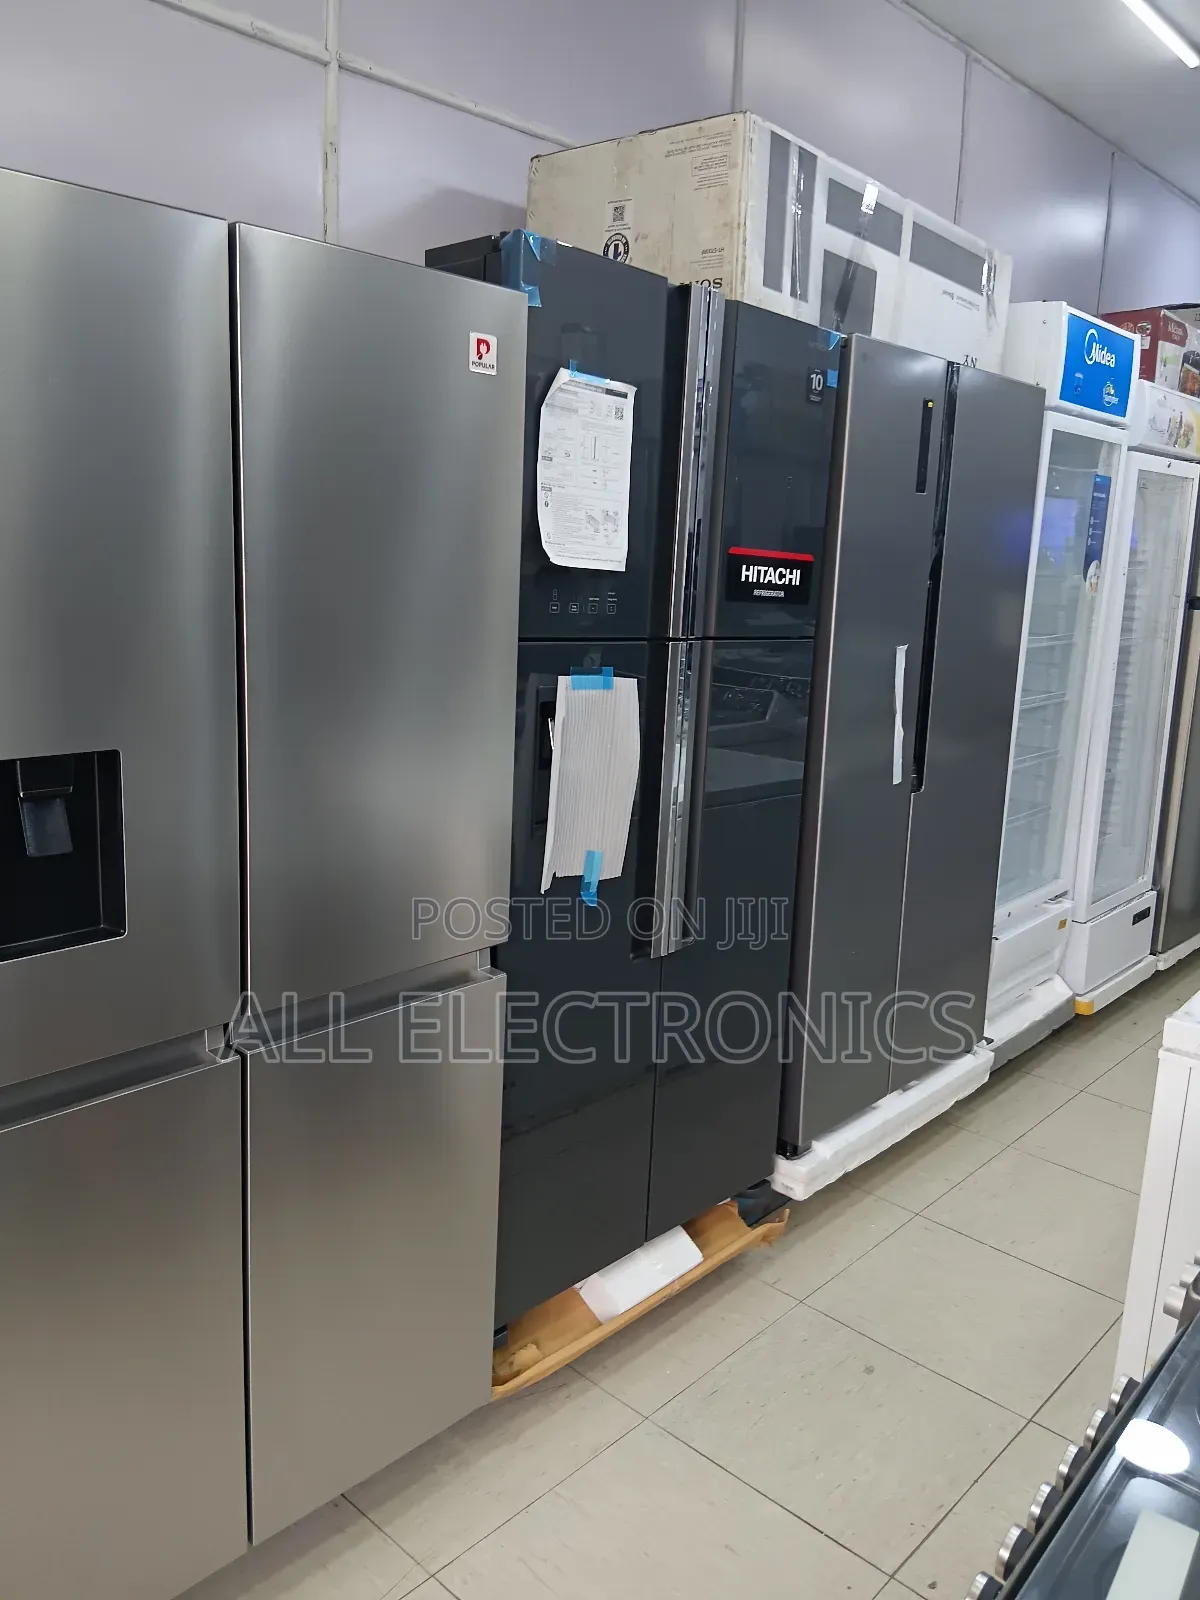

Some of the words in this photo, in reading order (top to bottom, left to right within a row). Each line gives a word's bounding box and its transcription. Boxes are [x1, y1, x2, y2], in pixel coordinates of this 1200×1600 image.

[1085, 331, 1116, 368] Midea
[471, 361, 495, 370] POPULAR
[810, 373, 824, 391] 10
[741, 564, 801, 586] HITACHI
[753, 589, 785, 598] REFRIGERATOR
